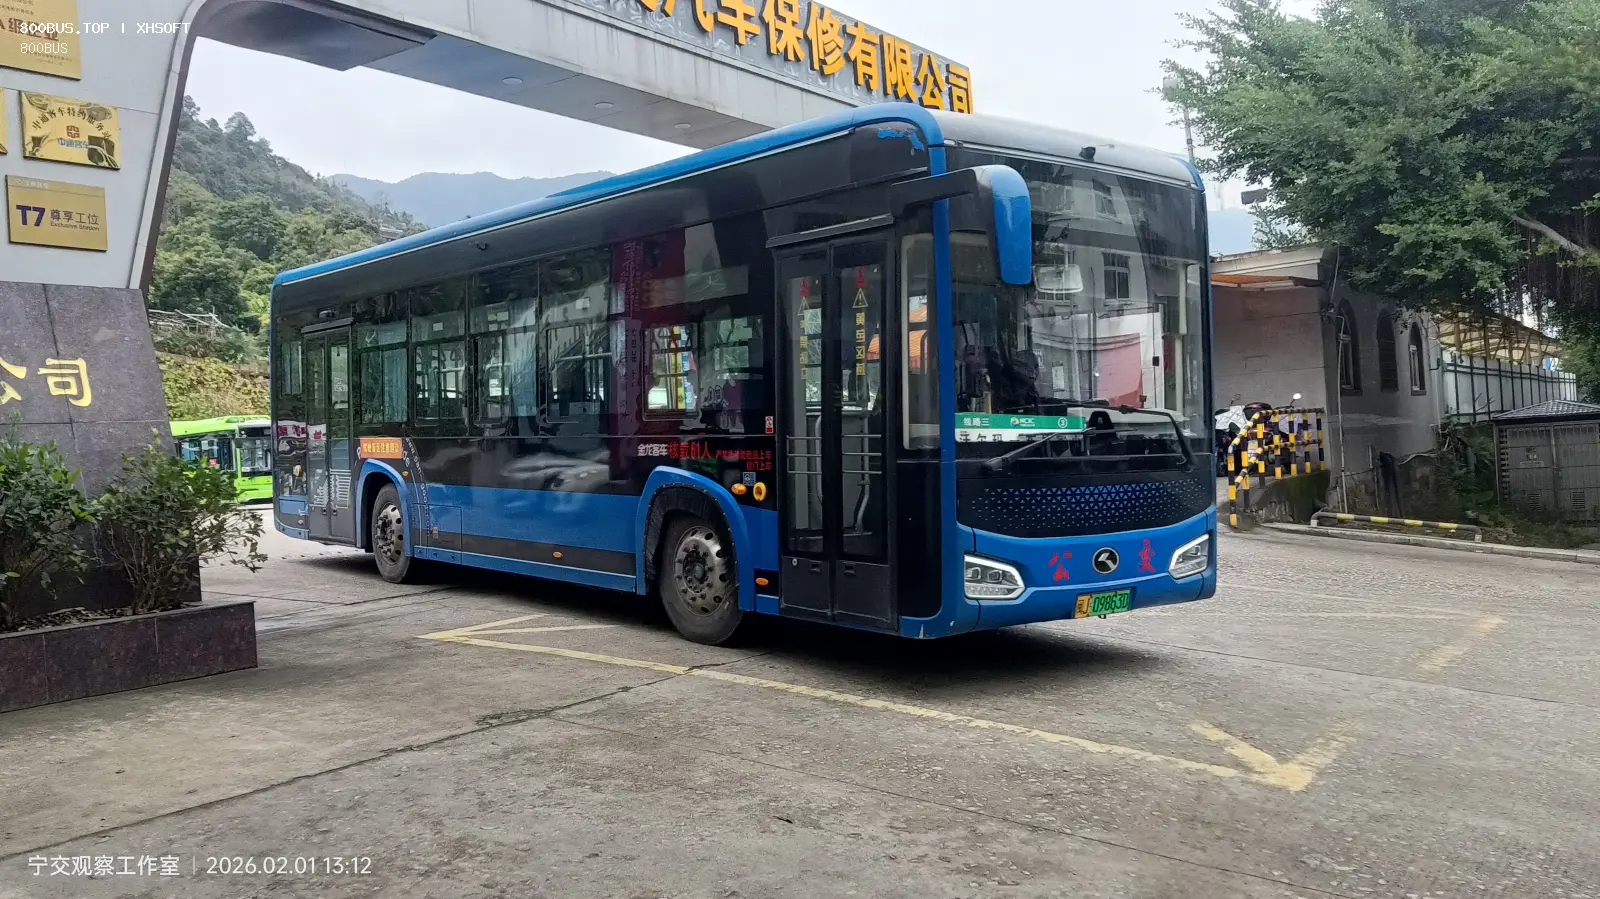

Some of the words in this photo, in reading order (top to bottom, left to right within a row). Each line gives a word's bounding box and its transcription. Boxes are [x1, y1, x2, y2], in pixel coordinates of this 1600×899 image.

[640, 0, 974, 115] 车保修有限公司
[16, 204, 46, 228] T7
[50, 208, 100, 226] 尊享工位
[637, 443, 668, 457] 金龙客车
